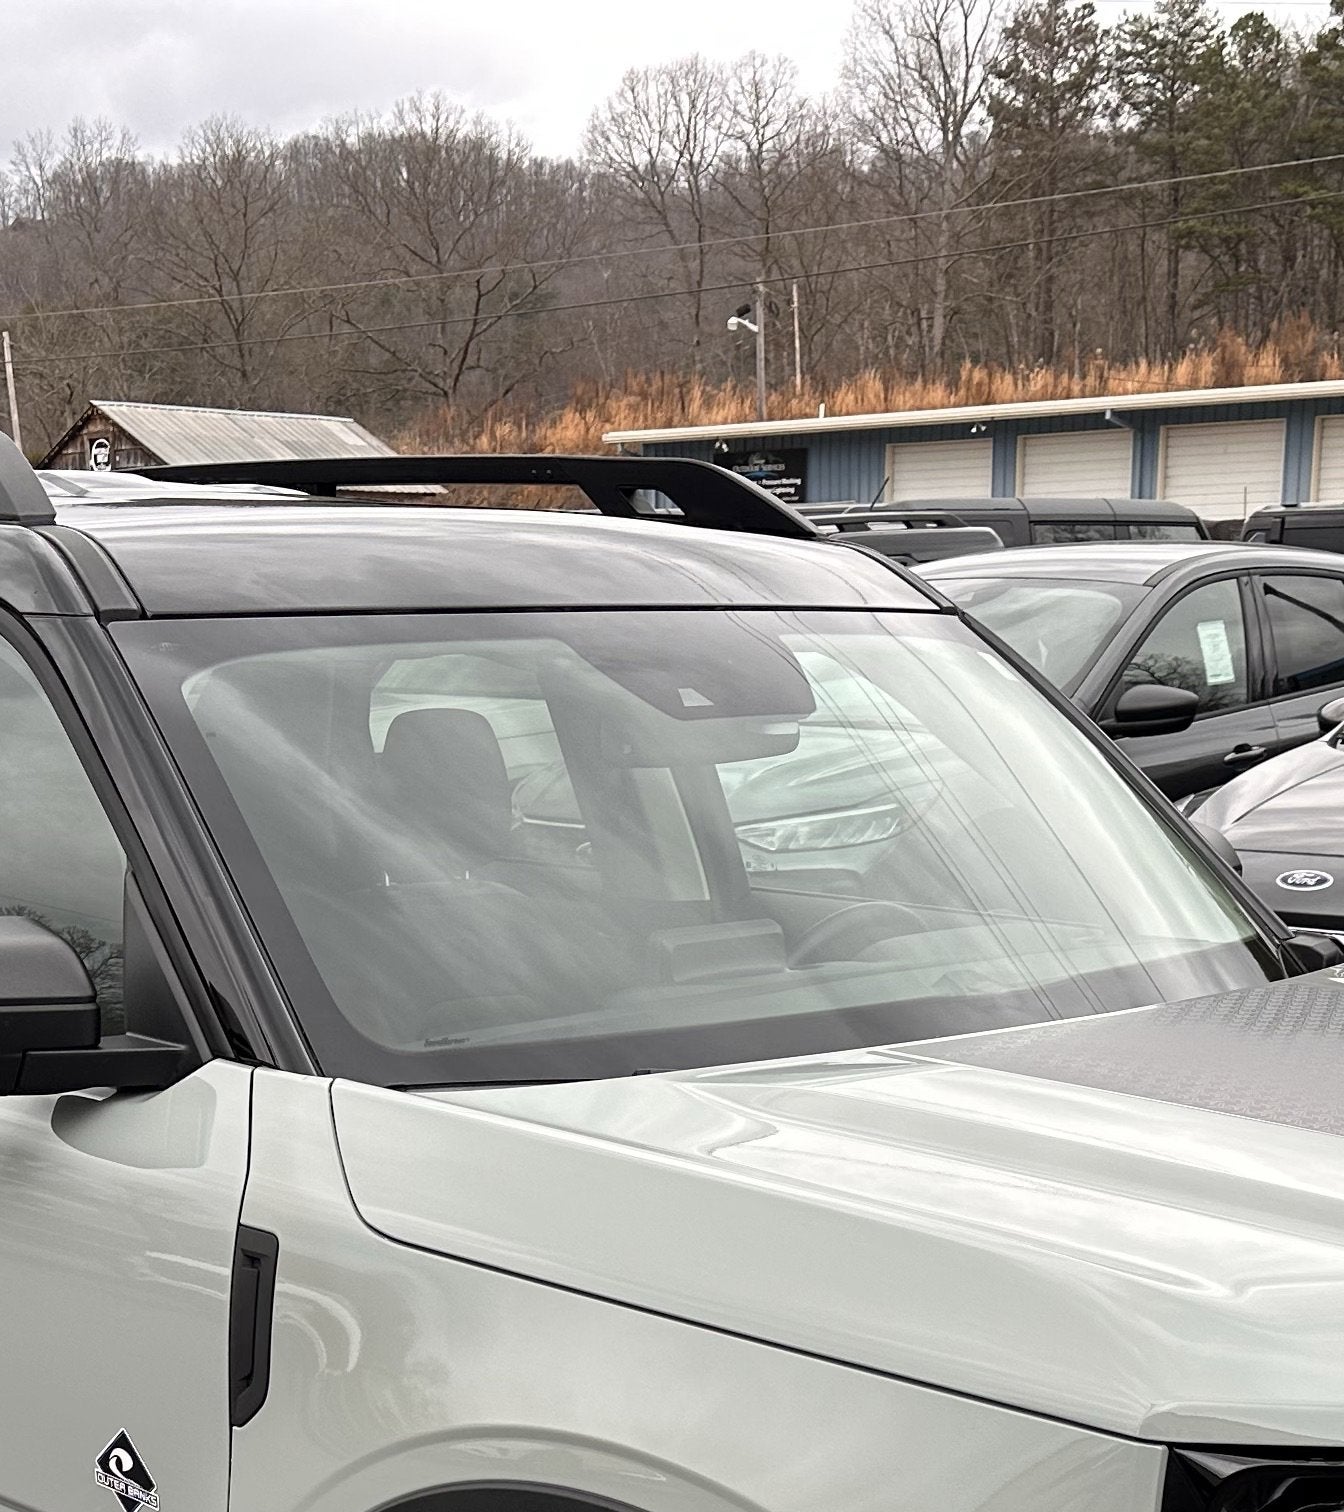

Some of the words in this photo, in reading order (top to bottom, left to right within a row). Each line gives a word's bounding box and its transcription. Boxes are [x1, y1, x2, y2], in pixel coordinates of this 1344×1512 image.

[1287, 871, 1322, 886] Ford
[96, 1472, 126, 1494] OUTER
[127, 1484, 157, 1507] BANKS
